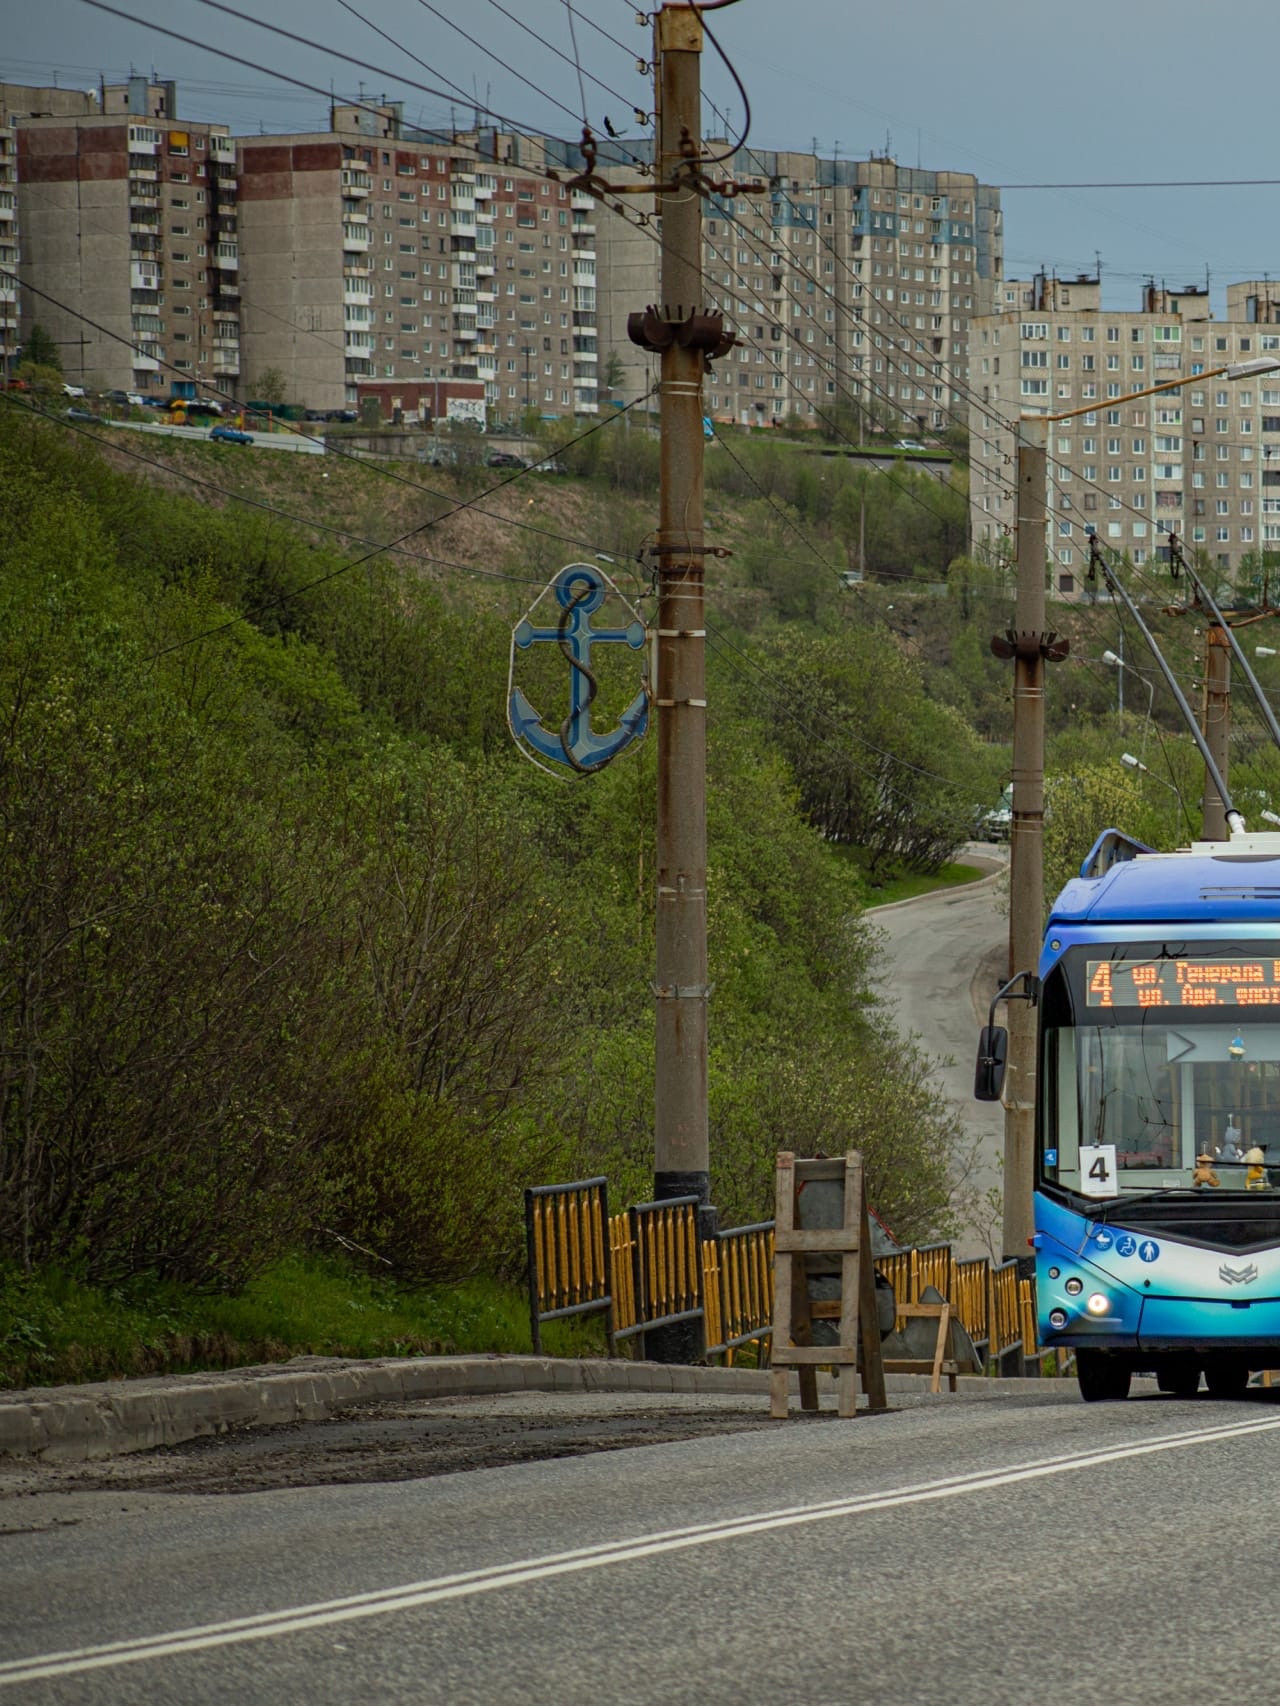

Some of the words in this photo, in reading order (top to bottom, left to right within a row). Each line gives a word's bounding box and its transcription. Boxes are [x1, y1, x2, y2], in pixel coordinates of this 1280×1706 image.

[1091, 962, 1113, 1007] 4
[1132, 966, 1164, 985] ул.
[1175, 961, 1265, 984] Генерала
[1138, 987, 1170, 1007] ул.
[1181, 983, 1224, 1007] Адм.
[1089, 1157, 1109, 1182] 4
